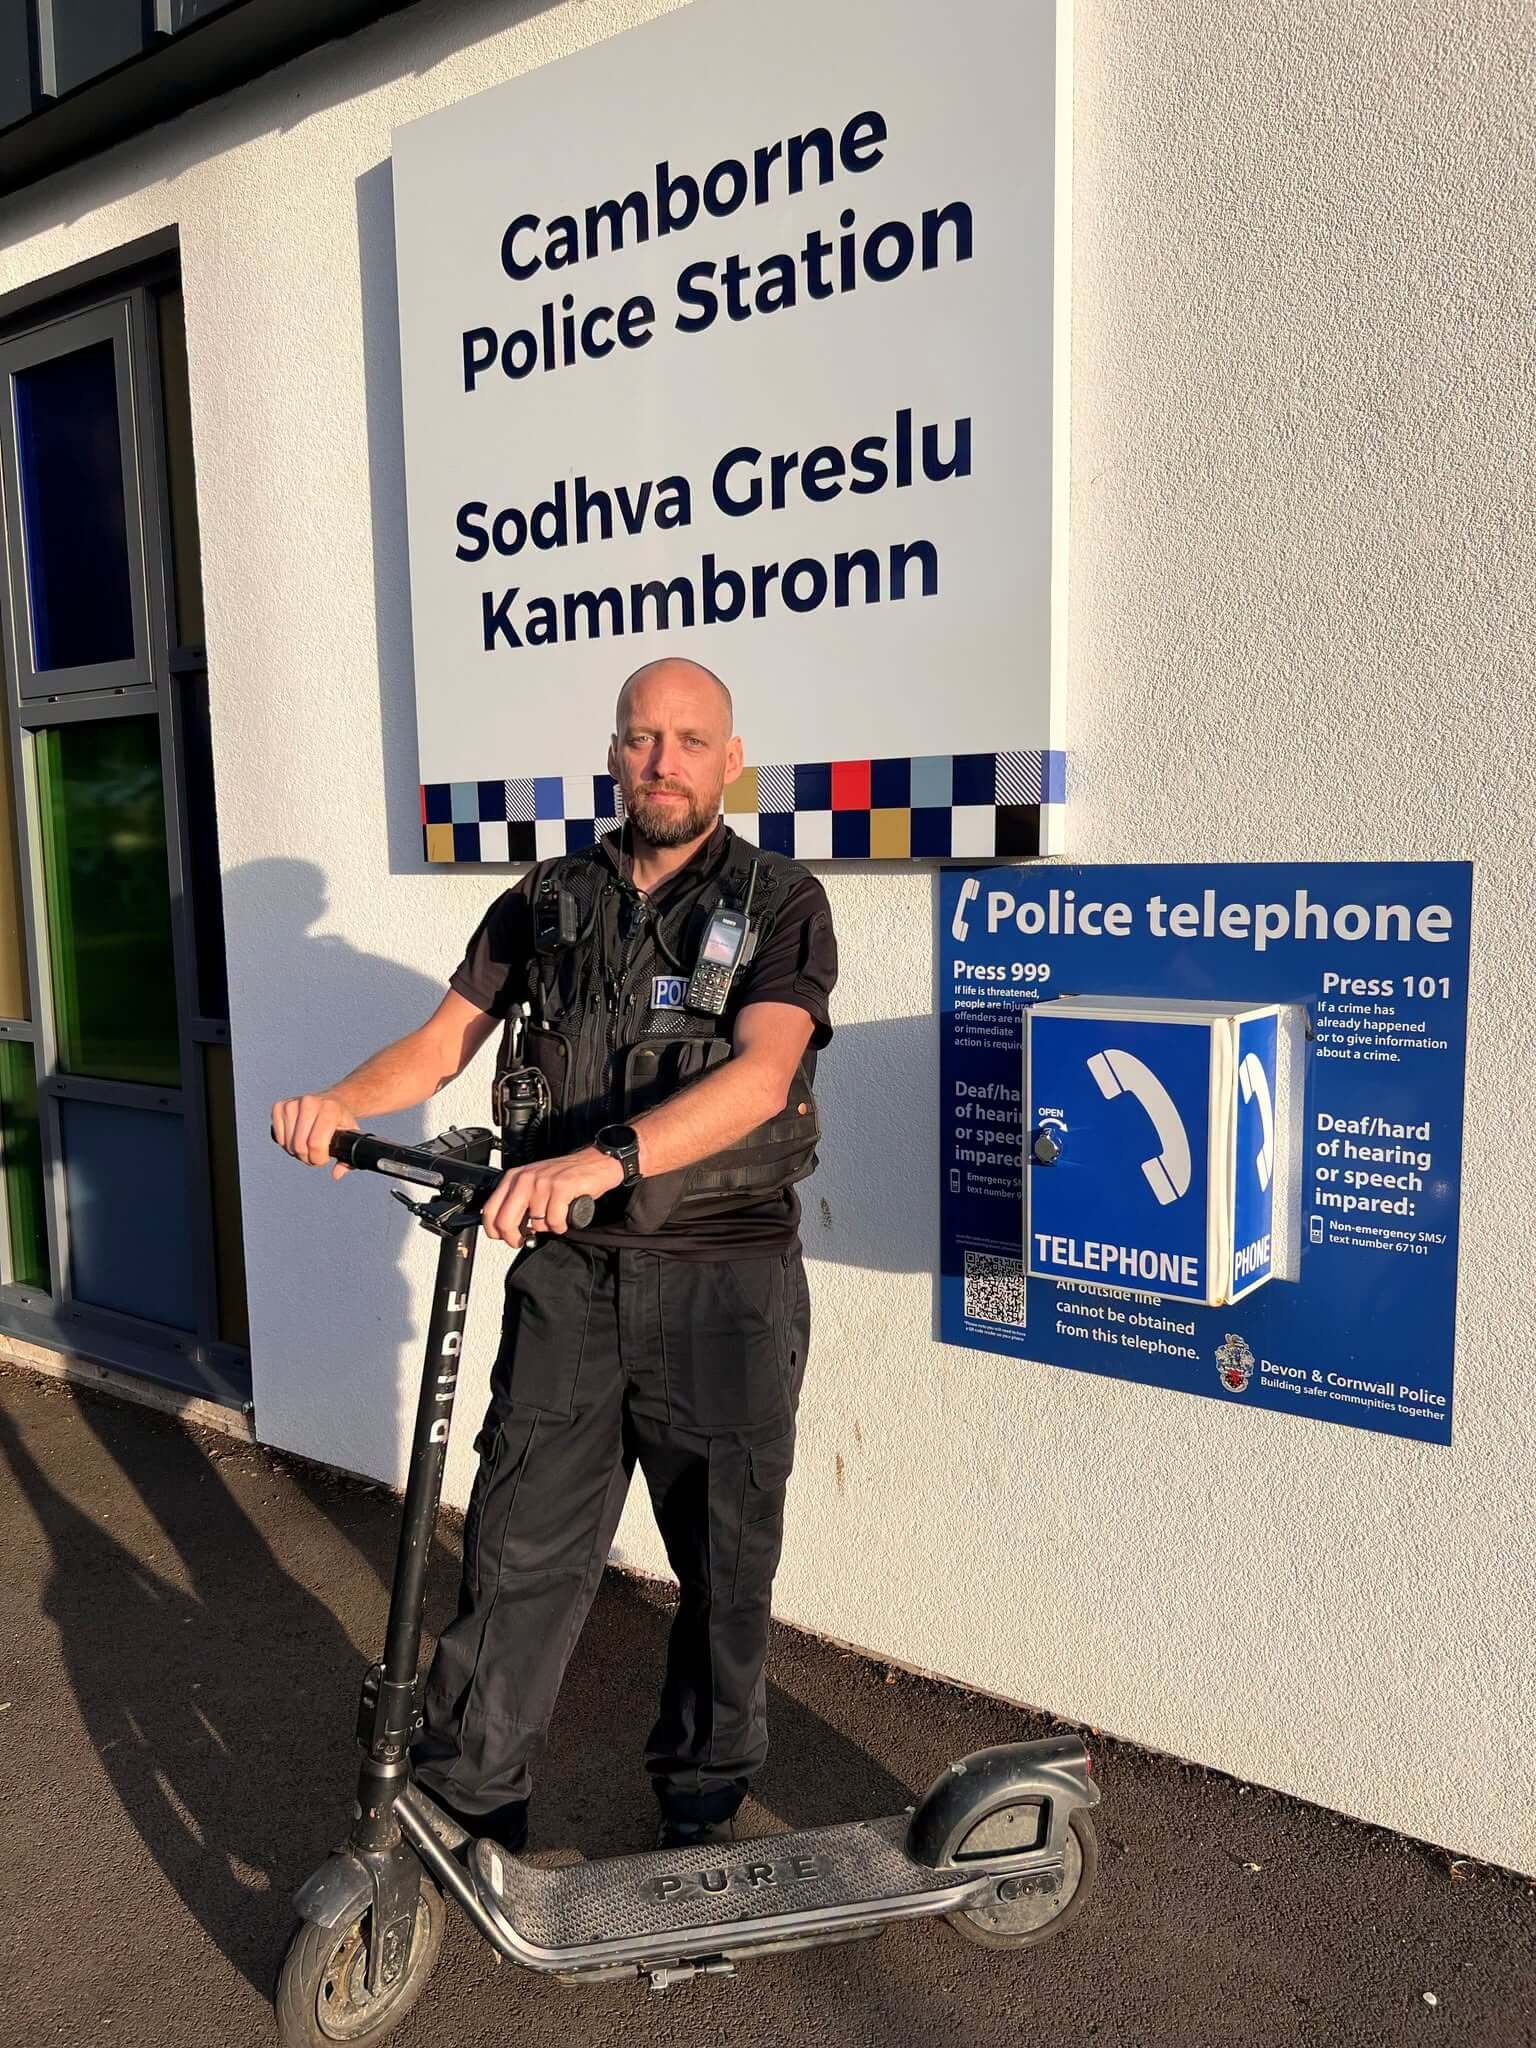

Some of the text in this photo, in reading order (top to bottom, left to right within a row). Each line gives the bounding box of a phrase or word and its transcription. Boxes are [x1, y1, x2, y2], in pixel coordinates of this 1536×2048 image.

[500, 110, 887, 281] Camborne
[462, 201, 973, 393] Police Station
[455, 408, 972, 563] Sodhva Greslu
[481, 538, 938, 652] Kammbronn
[987, 889, 1452, 951] Police telephone
[953, 960, 1051, 982] Press 999
[954, 985, 1040, 999] If life is threatened,
[1323, 972, 1450, 999] Press 101
[954, 999, 985, 1012] people
[987, 1001, 1001, 1009] are
[954, 1011, 997, 1023] offenders
[998, 1014, 1016, 1023] are
[1318, 1001, 1395, 1015] If a crime has
[954, 1024, 1014, 1037] or immediate
[1317, 1017, 1425, 1033] already happened
[954, 1037, 982, 1048] action
[983, 1039, 991, 1048] is
[1317, 1033, 1448, 1050] or to give information
[1316, 1047, 1401, 1062] about a crime.
[955, 1081, 1021, 1101] Deaf/ha
[955, 1104, 974, 1119] of
[1038, 1107, 1064, 1118] OPEN
[955, 1126, 974, 1140] or
[1317, 1113, 1431, 1141] Deaf/hard
[1316, 1138, 1432, 1171] of hearing
[967, 1172, 1012, 1187] Emergency
[1316, 1166, 1423, 1192] or speech
[967, 1185, 982, 1194] text
[983, 1187, 1015, 1199] number
[1315, 1187, 1416, 1217] impared:
[1329, 1220, 1446, 1245] Non-emergency SMS/
[1329, 1234, 1428, 1255] text number 67101
[1034, 1233, 1199, 1287] TELEPHONE
[1235, 1234, 1270, 1280] PHONE
[1056, 1280, 1075, 1291] An
[1079, 1283, 1131, 1301] outside
[1056, 1301, 1195, 1336] cannot be obtained
[1056, 1320, 1201, 1361] from this telephone.
[1261, 1359, 1446, 1407] Devon & Cornwall Police
[1261, 1376, 1445, 1421] Building safer communities together
[655, 1856, 819, 1900] PURE
